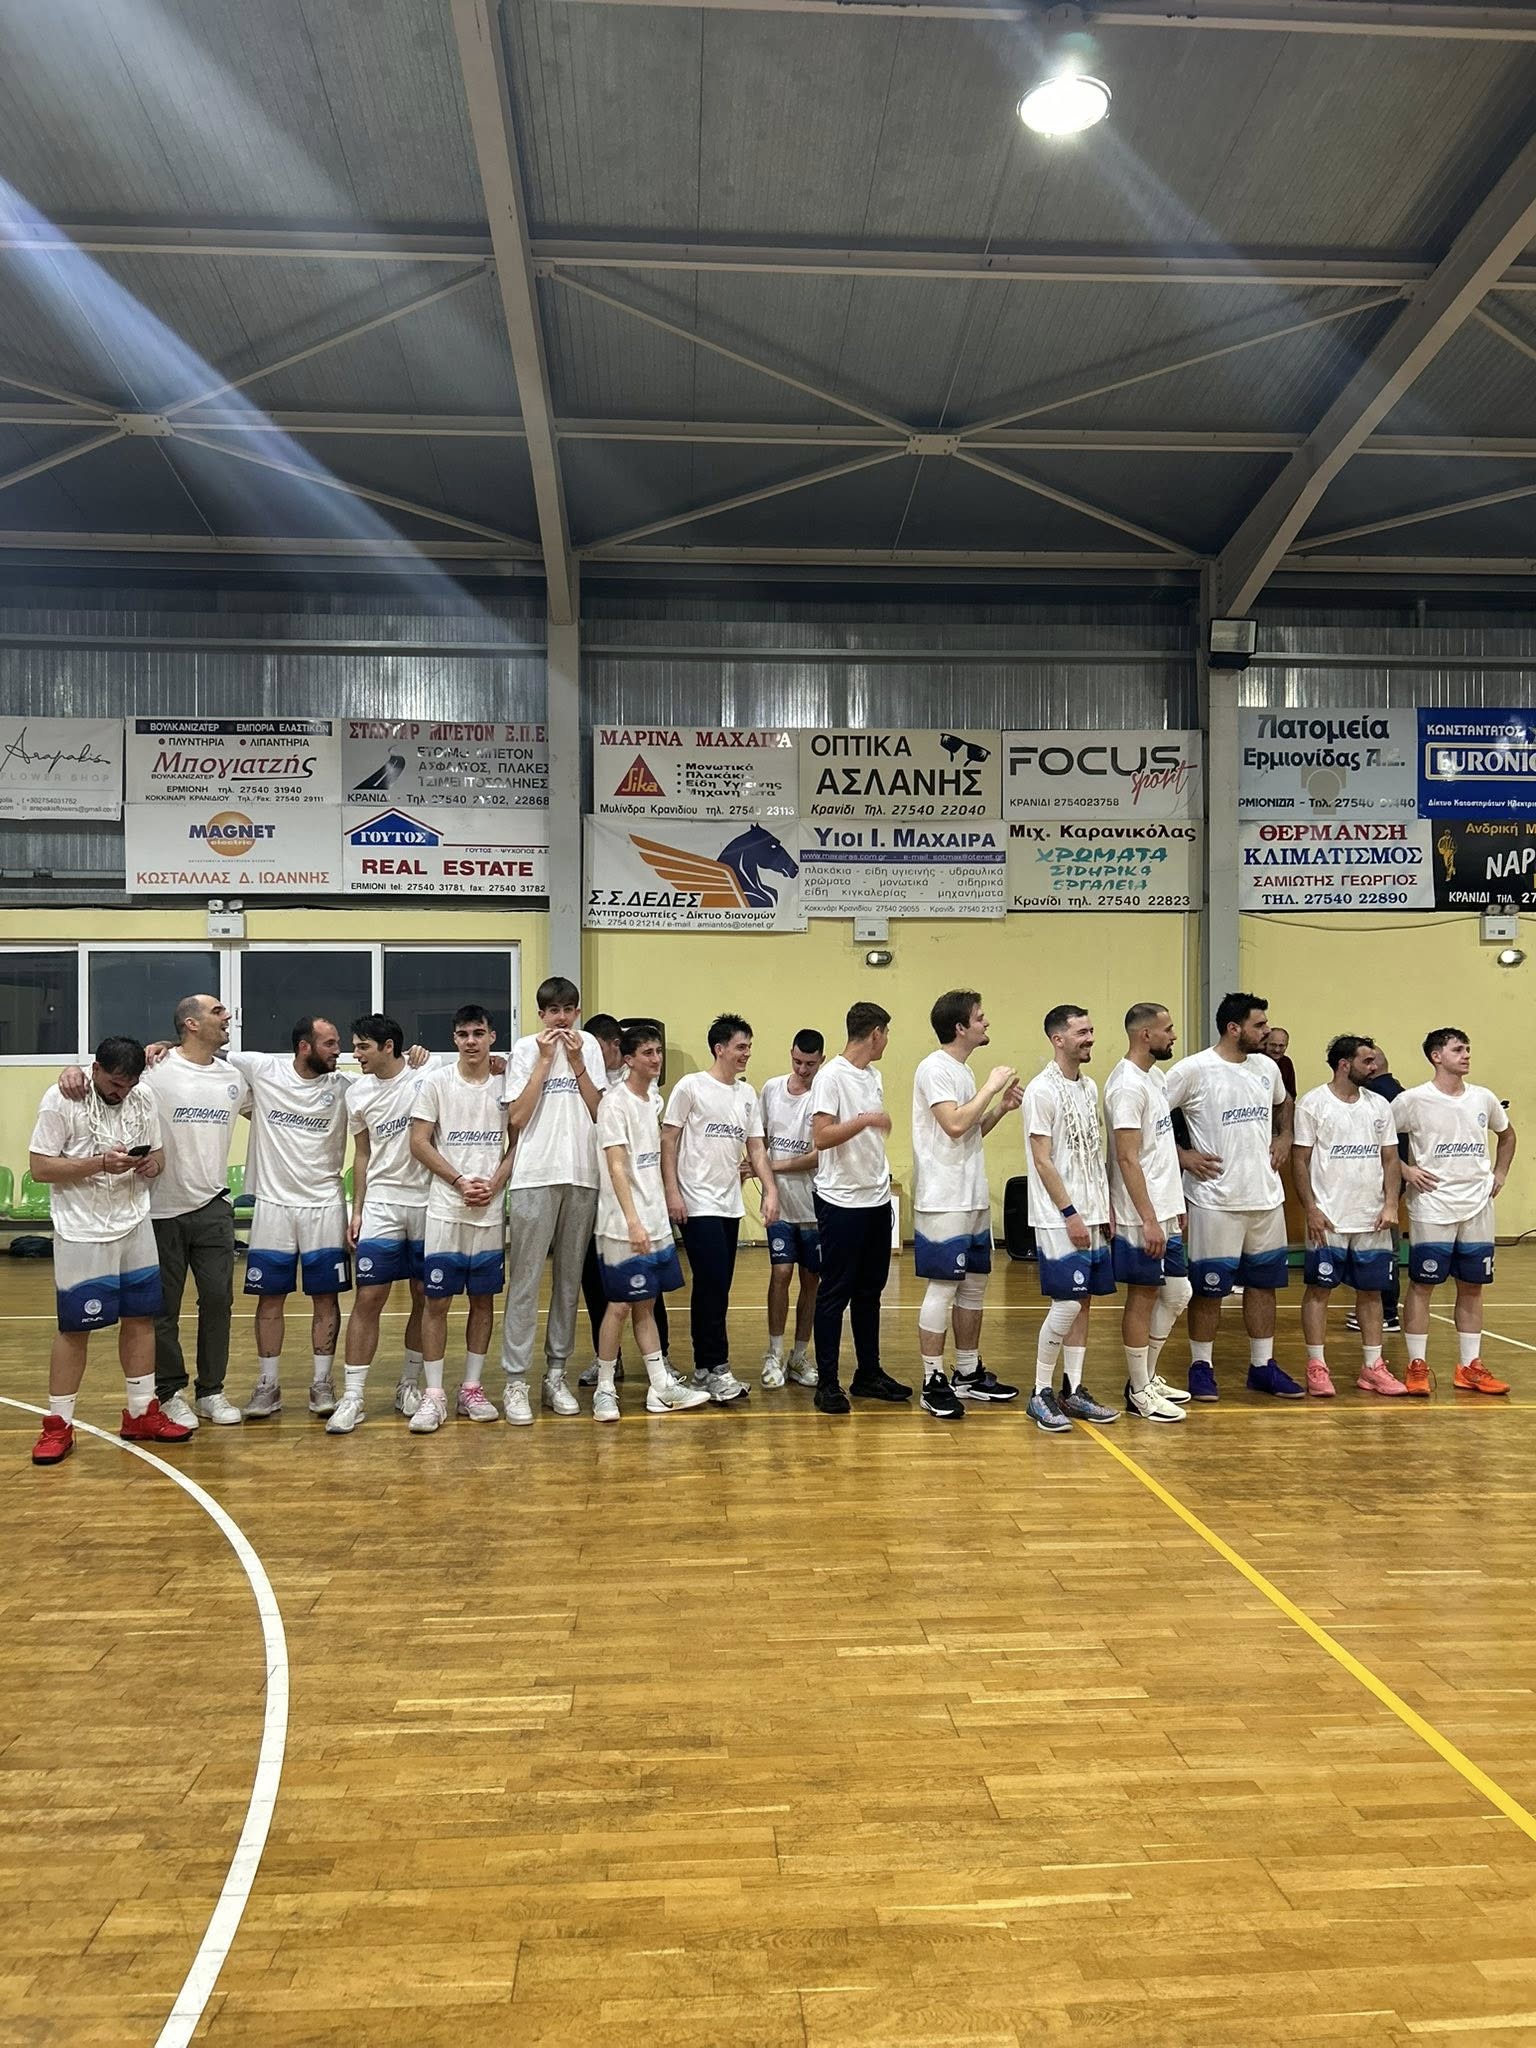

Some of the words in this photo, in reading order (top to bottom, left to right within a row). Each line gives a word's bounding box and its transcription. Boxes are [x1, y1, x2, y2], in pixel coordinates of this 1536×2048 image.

[150, 723, 220, 732] ΒΟΥΛΚΑΝΙΖΑΤΕΡ
[236, 724, 275, 732] ΕΜΠΟΡΙΑ
[429, 723, 495, 741] ΜΠΕΤΟΝ
[505, 725, 549, 742] Ε.Π.Ε.
[1257, 714, 1390, 744] Λατομεία
[1427, 724, 1523, 736] ΚΩΝΣΤΑΝΤΑΤΟΣ
[168, 738, 225, 746] ΠΛΥΝΤΗΡΙΑ
[250, 739, 310, 747] ΛΙΠΑΝΤΗΡΙΑ
[600, 730, 683, 746] ΜΑΡΙΝΑ
[696, 731, 793, 748] ΜΑΧΑΙΡΑ
[811, 734, 912, 757] ΟΠΤΙΚΑ
[152, 751, 317, 779] Μπογιατζής
[1009, 746, 1181, 777] FOCUS
[1244, 747, 1361, 771] Ερμιονίδας
[686, 763, 754, 771] Μονωτικά
[1, 772, 60, 781] FLOWER
[71, 774, 110, 782] SHOP
[622, 767, 658, 793] Sika
[816, 768, 983, 796] ΑΣΛΑΝΗΣ
[1131, 760, 1198, 805] sport
[166, 785, 208, 793] ΕΡΜΙΟΝΗ
[218, 786, 234, 794] τηλ.
[240, 786, 269, 794] 27540
[274, 786, 302, 794] 31940
[686, 780, 717, 789] Είδη
[1308, 797, 1331, 808] Τηλ.
[1428, 798, 1452, 807] Δίκτυο
[600, 804, 645, 814] Μυλίνδρα
[650, 804, 698, 815] Κρανιδίου
[706, 805, 724, 815] τηλ.
[811, 804, 855, 816] Κρανίδι
[864, 804, 887, 816] Τηλ.
[891, 805, 935, 815] 27540
[941, 805, 986, 815] 22040
[188, 825, 276, 838] MAGNET
[1009, 824, 1051, 841] Μιχ.
[1060, 824, 1196, 841] Καρανικόλας
[1259, 824, 1408, 842] ΘΕΡΜΑΝΣΗ
[1465, 822, 1519, 836] Ανδρική
[360, 831, 427, 843] ΓΟΥΤΟΣ
[1035, 847, 1168, 863] ΧΡΩΜΑΤΑ
[1243, 847, 1423, 866] ΚΛΙΜΑΤΙΣΜΟΣ
[361, 859, 428, 875] REAL
[443, 860, 534, 876] ESTATE
[804, 867, 852, 875] πλακάκια
[865, 867, 888, 876] είδη
[892, 867, 936, 878] υγιεινής
[949, 867, 1004, 877] υδραυλικά
[136, 872, 231, 884] ΚΩΣΤΑΛΛΑΣ
[239, 873, 253, 884] Δ.
[259, 872, 330, 884] ΙΩΑΝΝΗΣ
[804, 878, 851, 887] χρώματα
[879, 878, 929, 888] μονωτικά
[957, 878, 1004, 888] σιδηρικά
[1253, 875, 1335, 887] ΣΑΜΙΩΤΗΣ
[1341, 874, 1418, 886] ΓΕΩΡΓΙΟΣ
[588, 890, 702, 908] Σ.Σ.ΔΕΔΕΣ
[804, 888, 829, 898] είδη
[842, 888, 907, 899] κιγκαλερίας
[938, 889, 1004, 899] μηχανήματα
[1262, 894, 1299, 905] ΤΗΛ.
[1304, 893, 1353, 905] 27540
[1358, 893, 1408, 904] 22890
[1449, 891, 1490, 903] ΚΡΑΝΙΔΙ
[1497, 894, 1515, 903] ΤΗΛ.
[1014, 895, 1061, 907] Κρανίδι
[1068, 897, 1092, 908] τηλ.
[1098, 895, 1140, 906] 27540
[1148, 895, 1191, 906] 22823
[588, 909, 678, 920] Αντιπροσωπείες
[686, 910, 722, 919] Δίκτυο
[724, 911, 776, 921] διανομών
